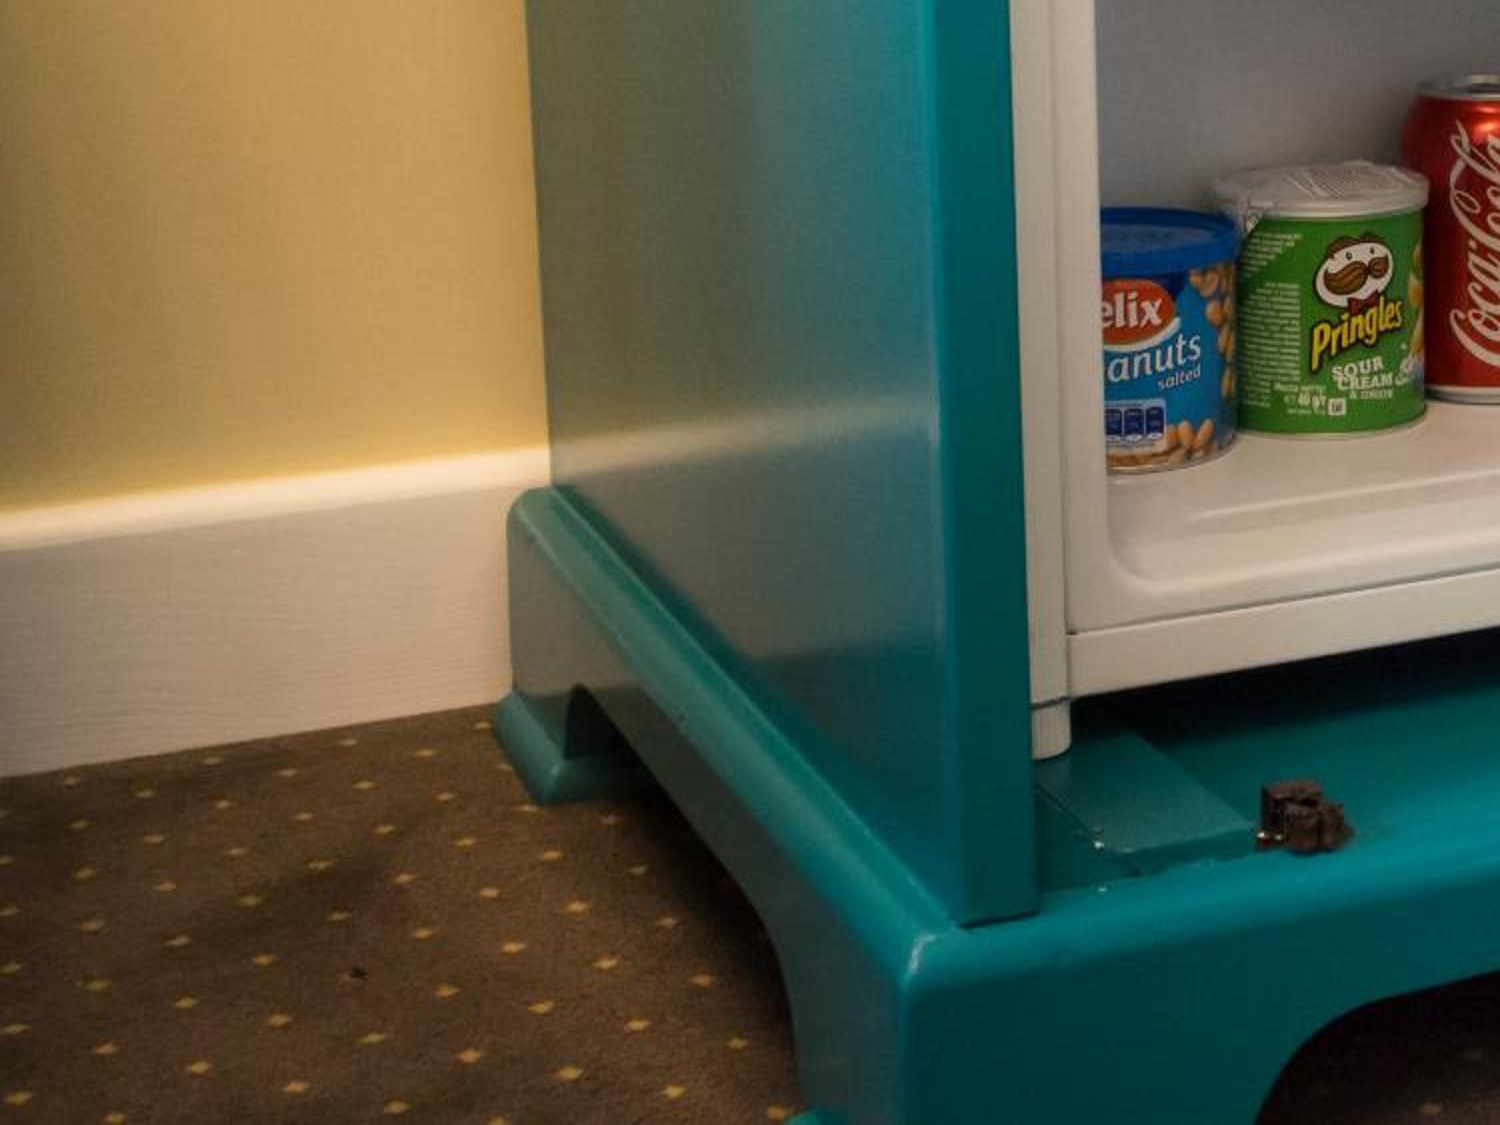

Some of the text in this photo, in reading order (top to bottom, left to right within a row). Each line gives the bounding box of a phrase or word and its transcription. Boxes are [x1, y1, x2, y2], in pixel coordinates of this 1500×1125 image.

[1310, 294, 1404, 373] Pringles
[1107, 332, 1201, 383] anuts
[1331, 355, 1385, 381] SOUR
[1157, 362, 1201, 392] salted
[1337, 372, 1393, 391] CREAM
